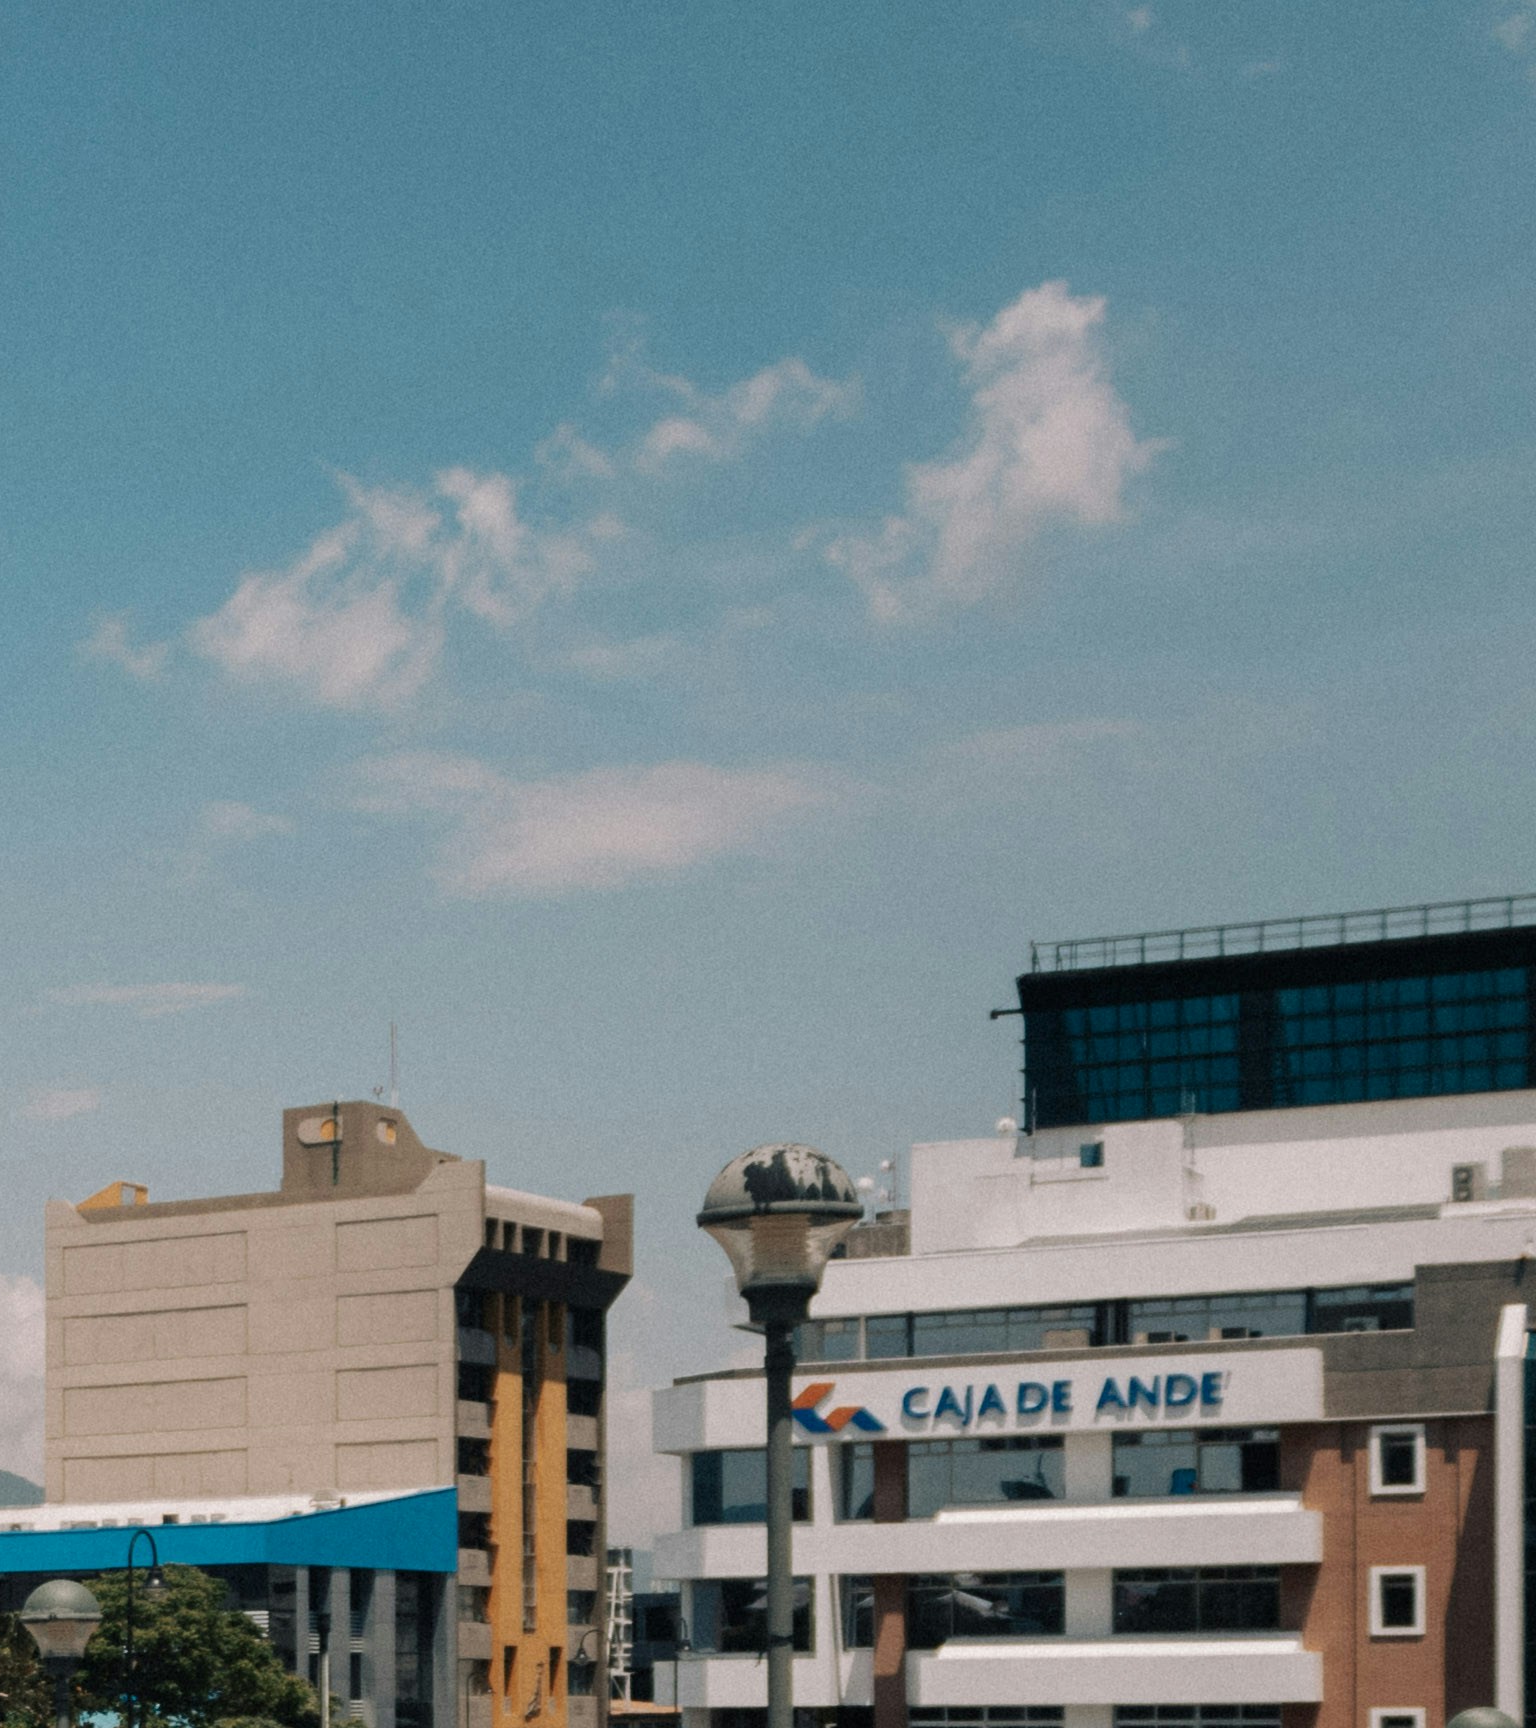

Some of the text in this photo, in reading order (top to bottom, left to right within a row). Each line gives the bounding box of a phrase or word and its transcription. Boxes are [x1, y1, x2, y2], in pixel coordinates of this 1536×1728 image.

[901, 1371, 1225, 1426] CAJA DE ANDE
